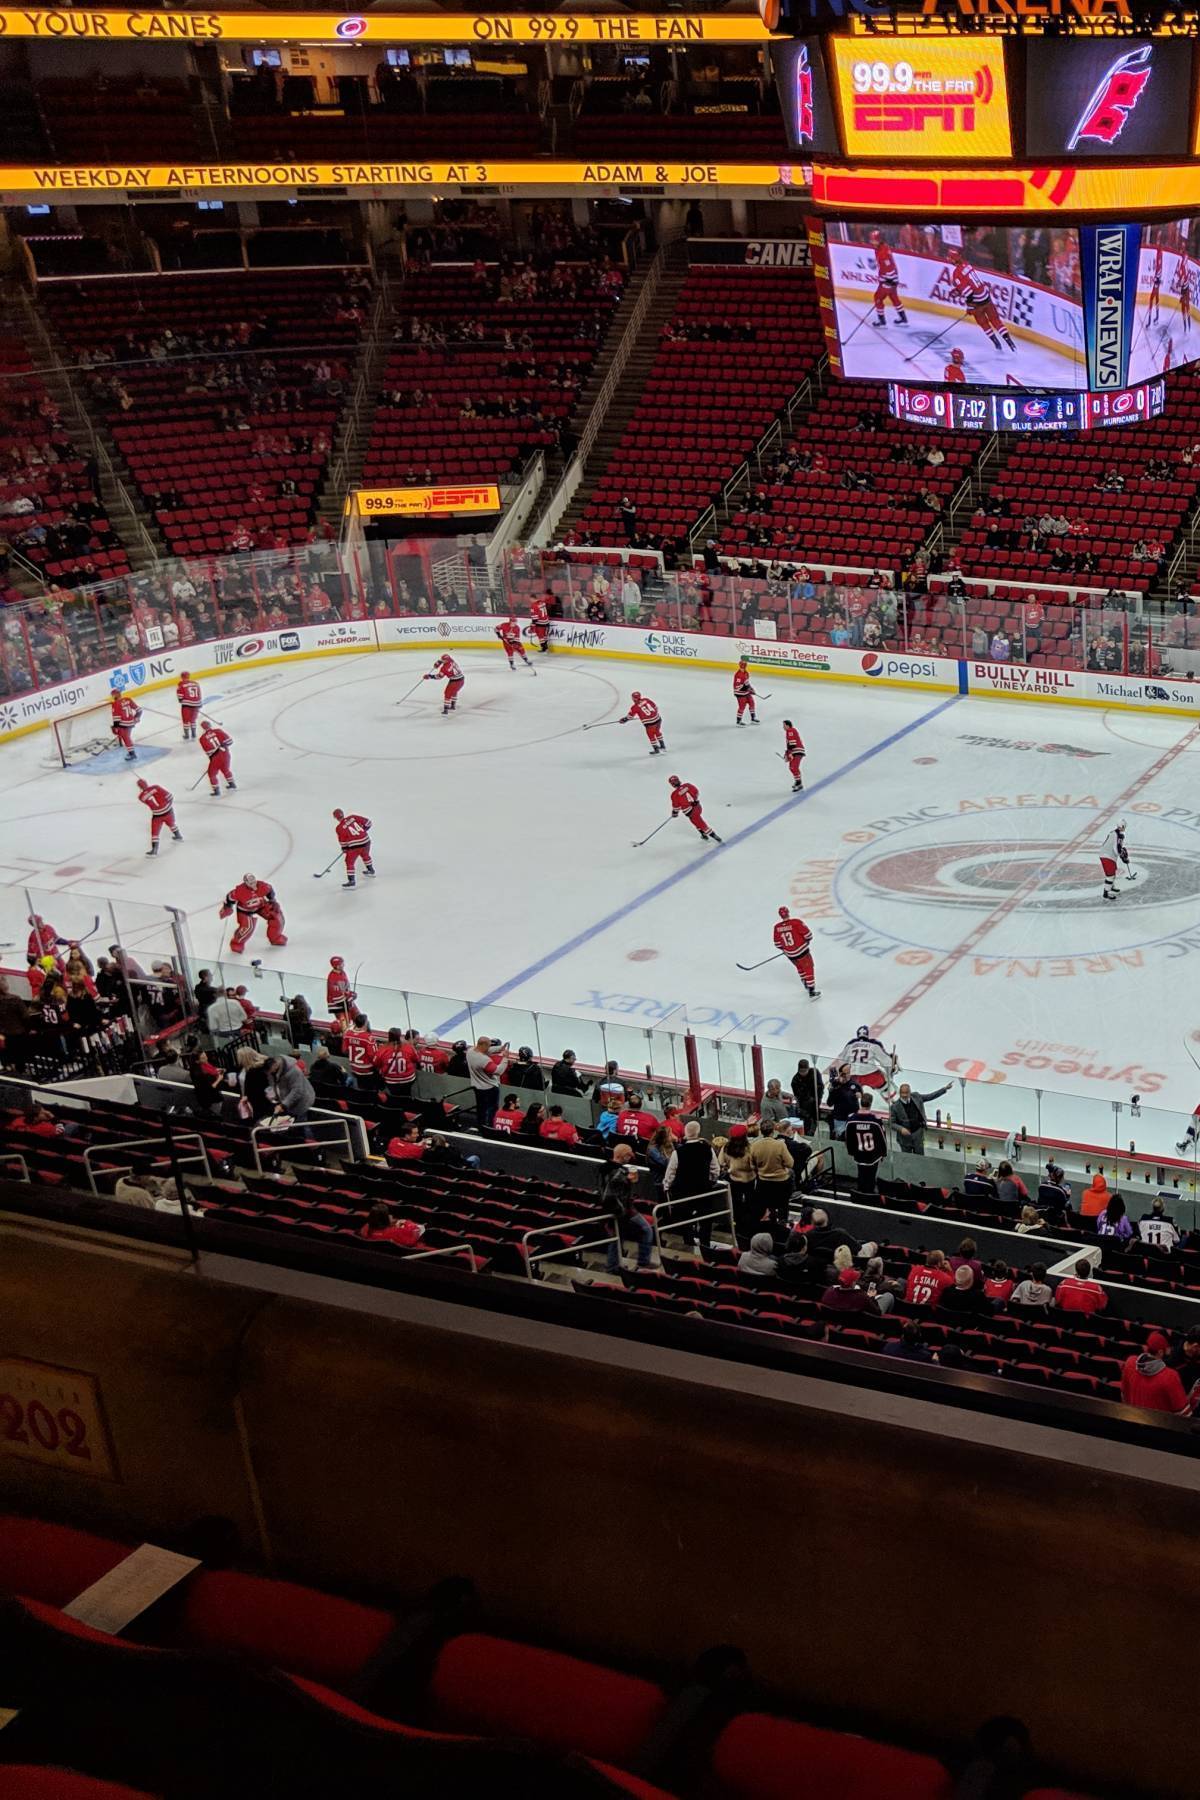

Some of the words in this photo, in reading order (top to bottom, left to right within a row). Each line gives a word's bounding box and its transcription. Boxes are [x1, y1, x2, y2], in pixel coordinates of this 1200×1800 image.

[24, 12, 111, 36] YOUR
[127, 14, 223, 38] CANES
[473, 17, 513, 39] ON
[529, 17, 578, 39] 99.9
[593, 18, 640, 38] THE
[655, 18, 704, 39] FAN
[853, 62, 913, 93] 99.9
[914, 80, 941, 92] THE
[854, 94, 975, 131] ESPN
[34, 169, 151, 187] WEEKDAY
[167, 167, 319, 185] AFTERNOONS
[332, 166, 433, 183] STARTING
[446, 166, 474, 182] AT
[476, 166, 488, 182] 3
[583, 166, 643, 182] ADAM
[655, 166, 668, 182] &
[681, 166, 718, 182] JOE
[1099, 231, 1123, 299] WRAL
[1099, 306, 1119, 385] NEWS
[934, 395, 945, 416] 0
[958, 399, 986, 419] 7:02
[1003, 399, 1016, 420] 0
[1066, 402, 1074, 416] 0
[1136, 389, 1144, 410] 0
[963, 421, 983, 430] FIRST
[1012, 421, 1031, 430] BLUE
[1033, 421, 1067, 430] JACKETS
[366, 497, 394, 509] 99.9
[432, 489, 489, 506] ESPN
[397, 626, 437, 635] VECTOR
[662, 634, 685, 646] DUKE
[214, 643, 235, 653] STREAM
[267, 639, 279, 650] ON
[282, 636, 299, 646] FOX
[663, 645, 698, 657] ENERGY
[215, 651, 234, 665] LIVE
[750, 645, 789, 659] Harris
[790, 649, 829, 662] Teeter
[150, 658, 175, 678] NC
[887, 659, 937, 678] pepsi
[974, 664, 1030, 683] BULLY
[1035, 670, 1075, 688] HILL
[992, 680, 1058, 695] VINEYARDS
[1096, 682, 1142, 698] Michael
[1171, 690, 1194, 704] Son
[21, 686, 86, 717] invisalign
[957, 794, 1100, 814] ARENA
[348, 821, 364, 837] 44
[865, 806, 949, 833] PNC
[790, 858, 838, 920] ARENA
[781, 932, 795, 947] 13
[820, 921, 902, 960] PNC
[970, 948, 1145, 979] ARENA
[573, 990, 680, 1019] REX
[682, 1006, 792, 1037] UNC
[348, 1045, 366, 1064] 12
[851, 1049, 869, 1064] 72
[1013, 1038, 1100, 1058] Health
[388, 1058, 407, 1075] 20
[1004, 1050, 1169, 1093] Syneos
[856, 1132, 875, 1152] 10
[1147, 1232, 1161, 1245] 11
[921, 1277, 939, 1289] STAAL
[912, 1284, 932, 1305] 12
[0, 1392, 93, 1461] 202
